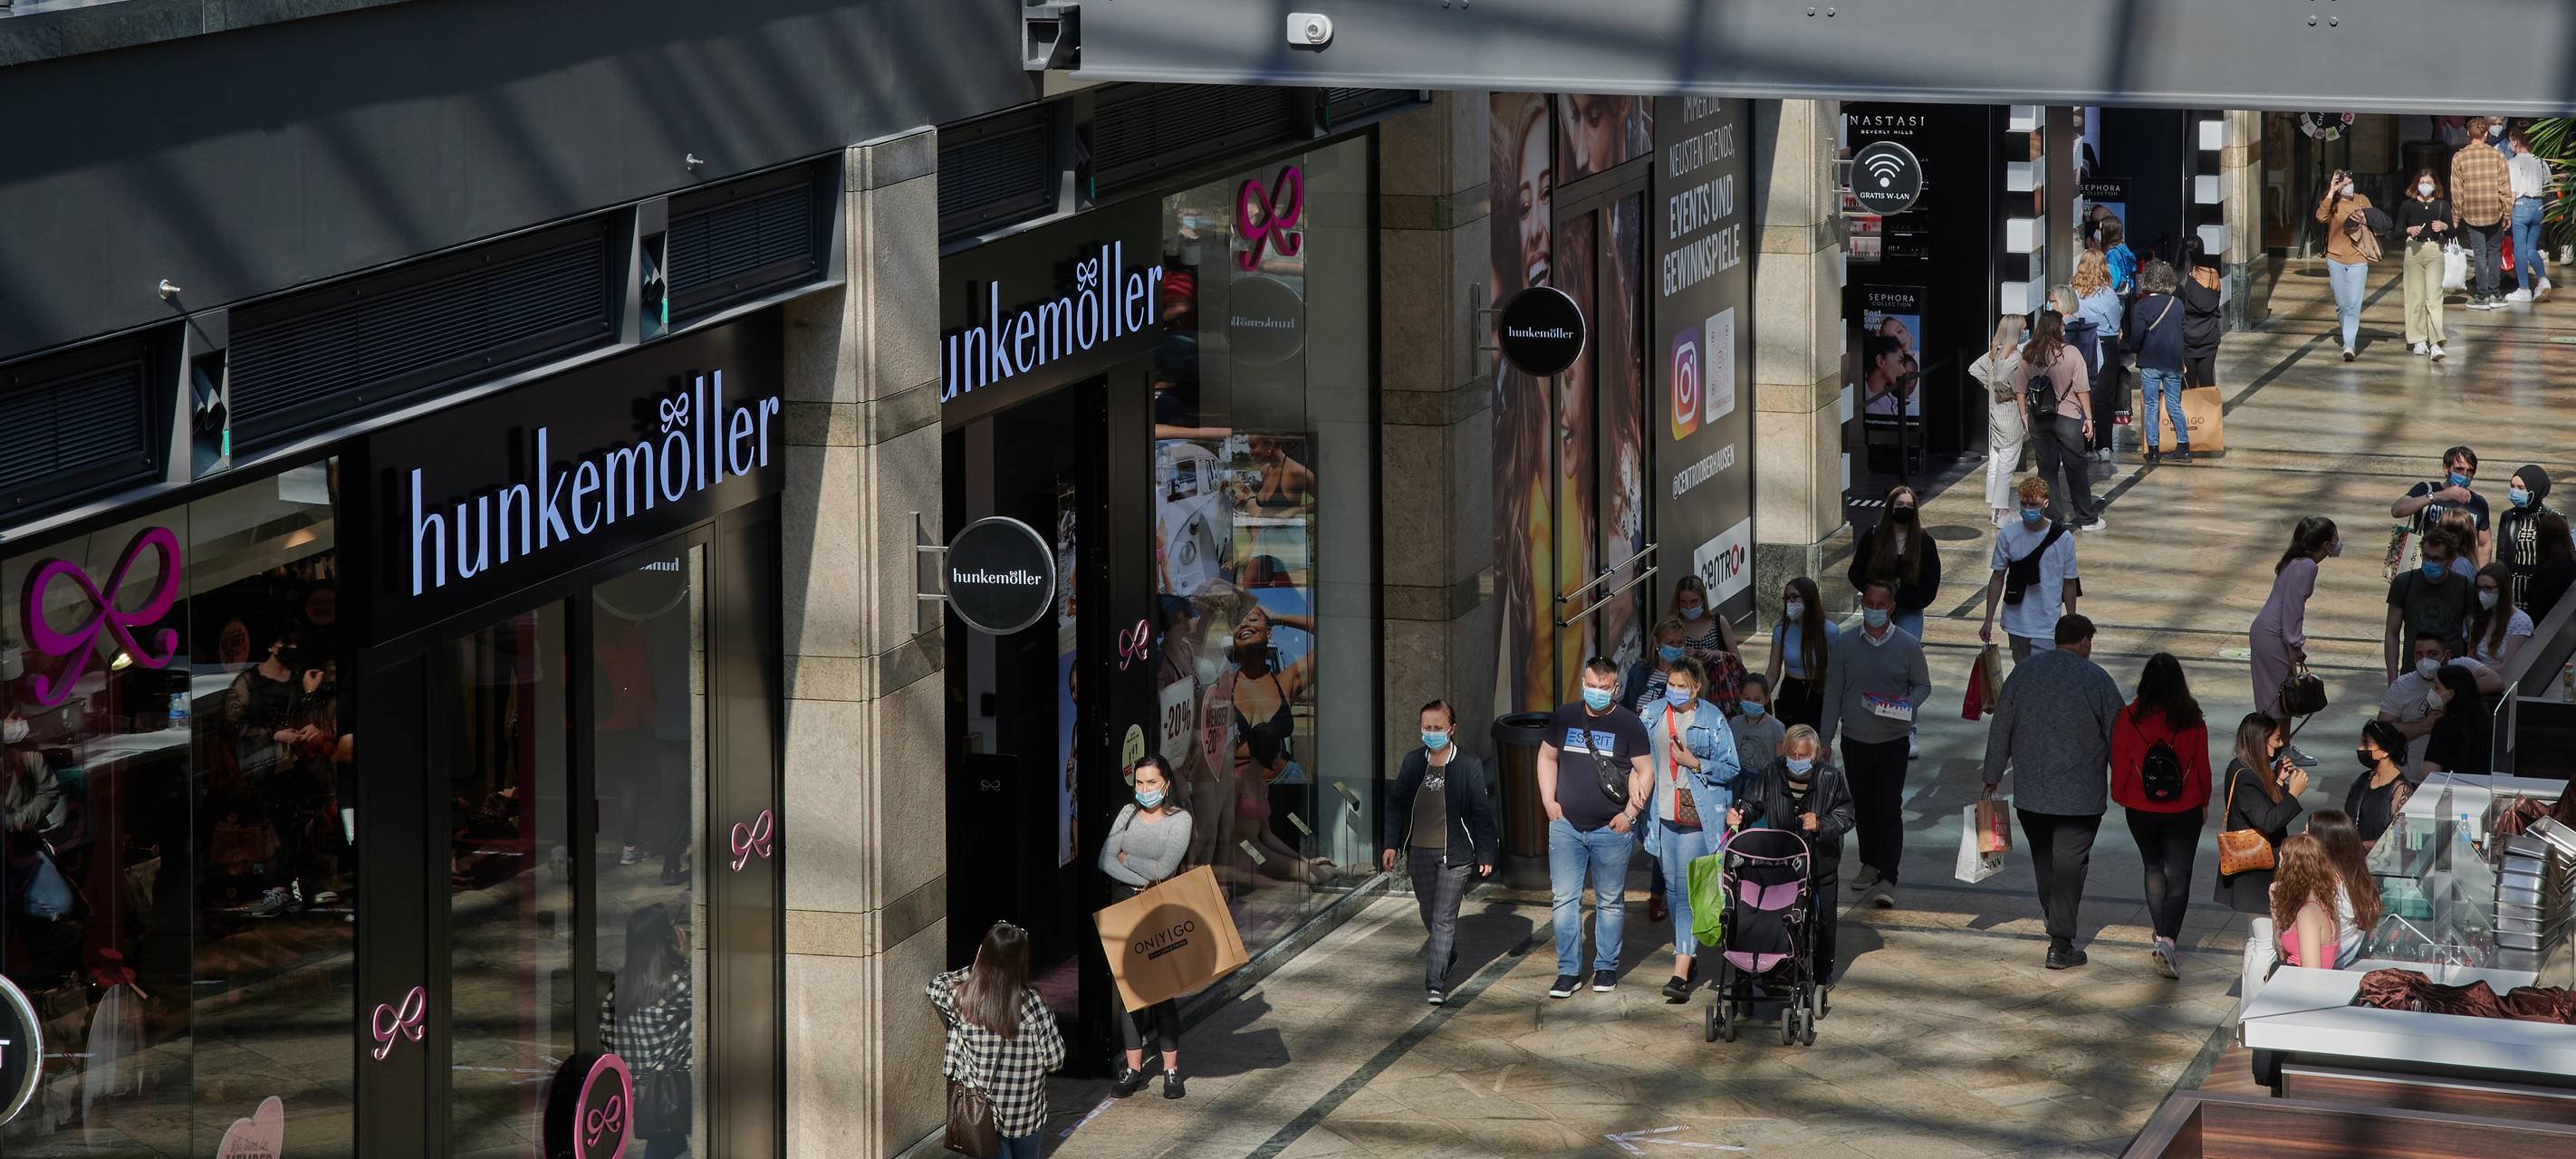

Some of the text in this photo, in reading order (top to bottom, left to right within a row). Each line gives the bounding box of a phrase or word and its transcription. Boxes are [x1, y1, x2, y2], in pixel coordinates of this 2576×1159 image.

[1669, 123, 1735, 178] NEUSTEN TRENDS,
[1670, 174, 1733, 240] EVENTS UND
[1860, 192, 1910, 200] GRATIS W-LAN
[1663, 224, 1740, 297] GEWINNSPIELE
[1869, 293, 1915, 302] SEPHORA
[1508, 326, 1574, 339] hunkemöller
[411, 369, 780, 597] hunkemöller
[953, 567, 1042, 585] hunkemöller
[1163, 698, 1191, 741] -20%
[1568, 731, 1612, 747] ESRIT
